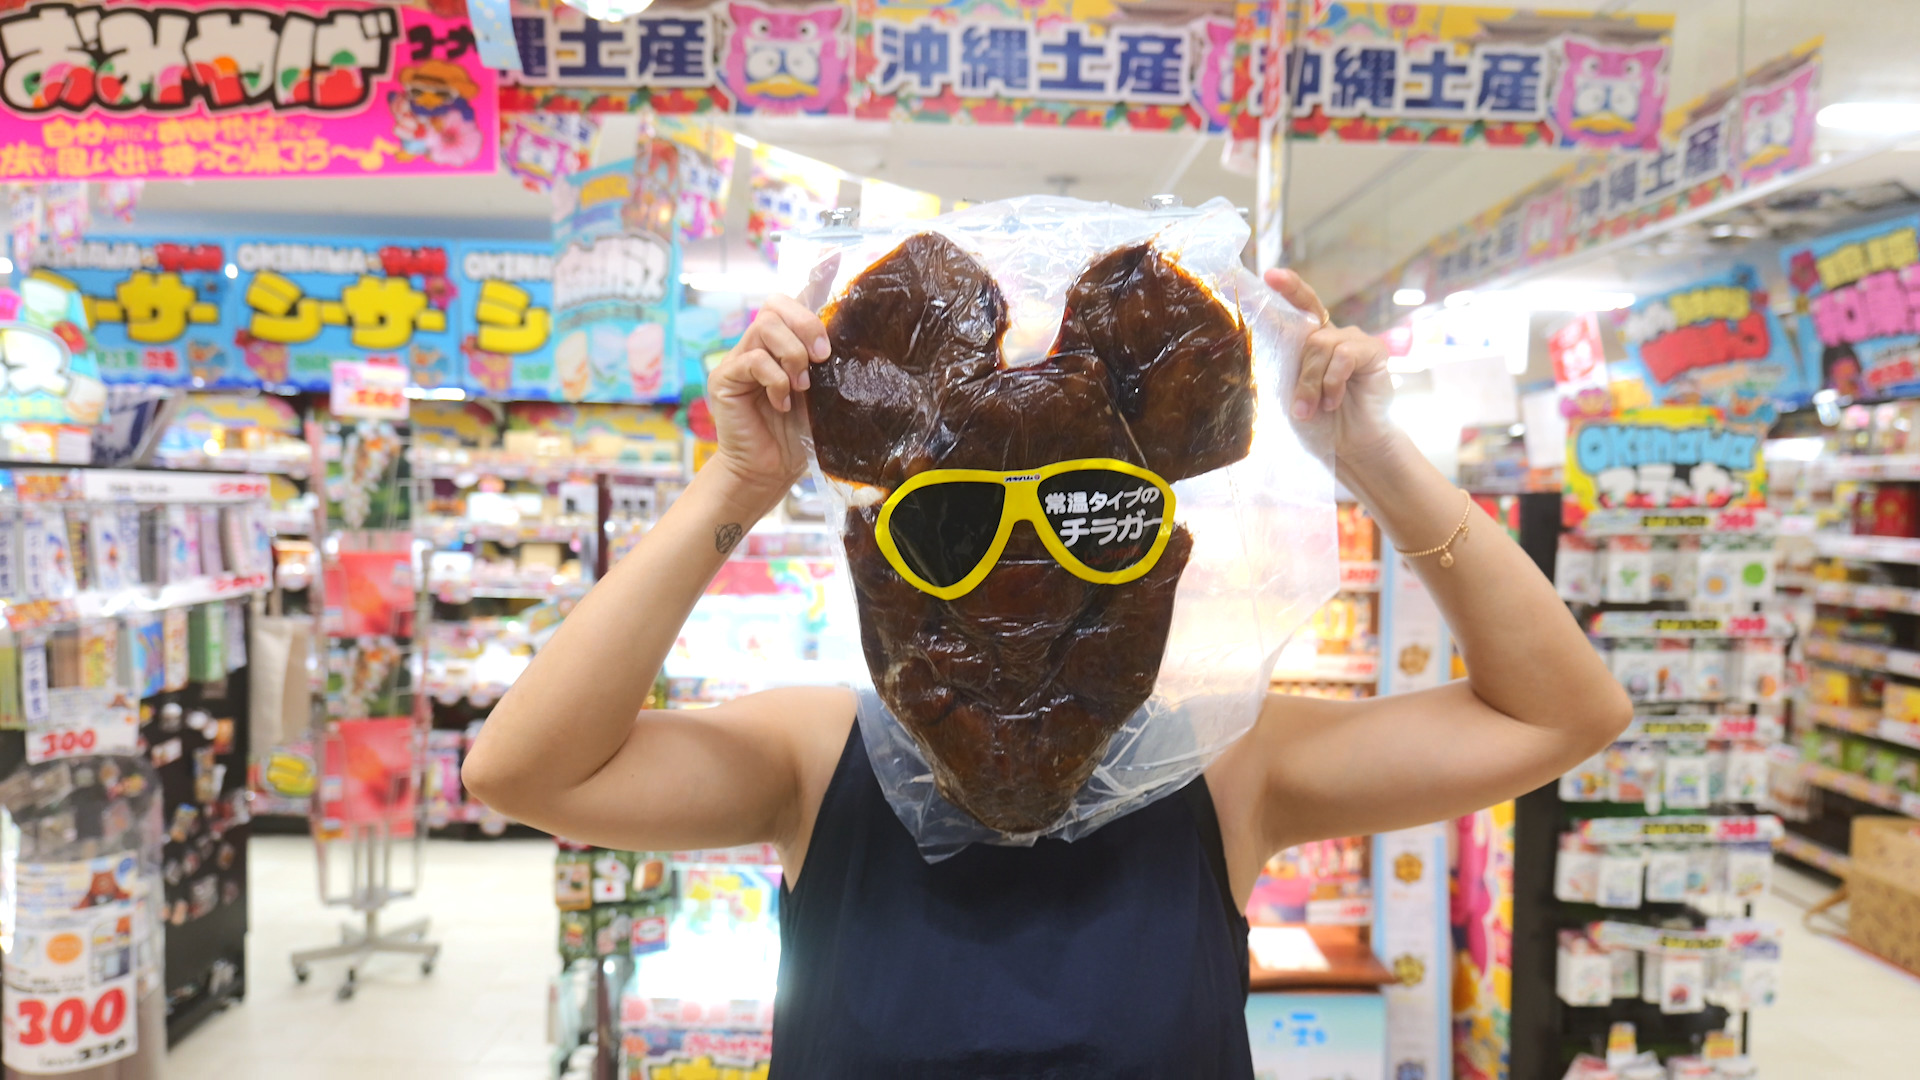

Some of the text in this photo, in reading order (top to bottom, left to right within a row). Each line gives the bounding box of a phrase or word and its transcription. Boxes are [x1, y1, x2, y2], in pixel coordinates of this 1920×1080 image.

[0, 4, 396, 110] おみやげ
[881, 25, 1184, 97] 沖縄土産
[36, 243, 141, 269] KINAWA
[32, 267, 219, 343] ーサー
[246, 270, 447, 349] シーサー
[1045, 486, 1160, 515] 常温タイプの
[1060, 509, 1163, 547] チラガー
[42, 729, 96, 759] 300
[18, 986, 127, 1045] 300
